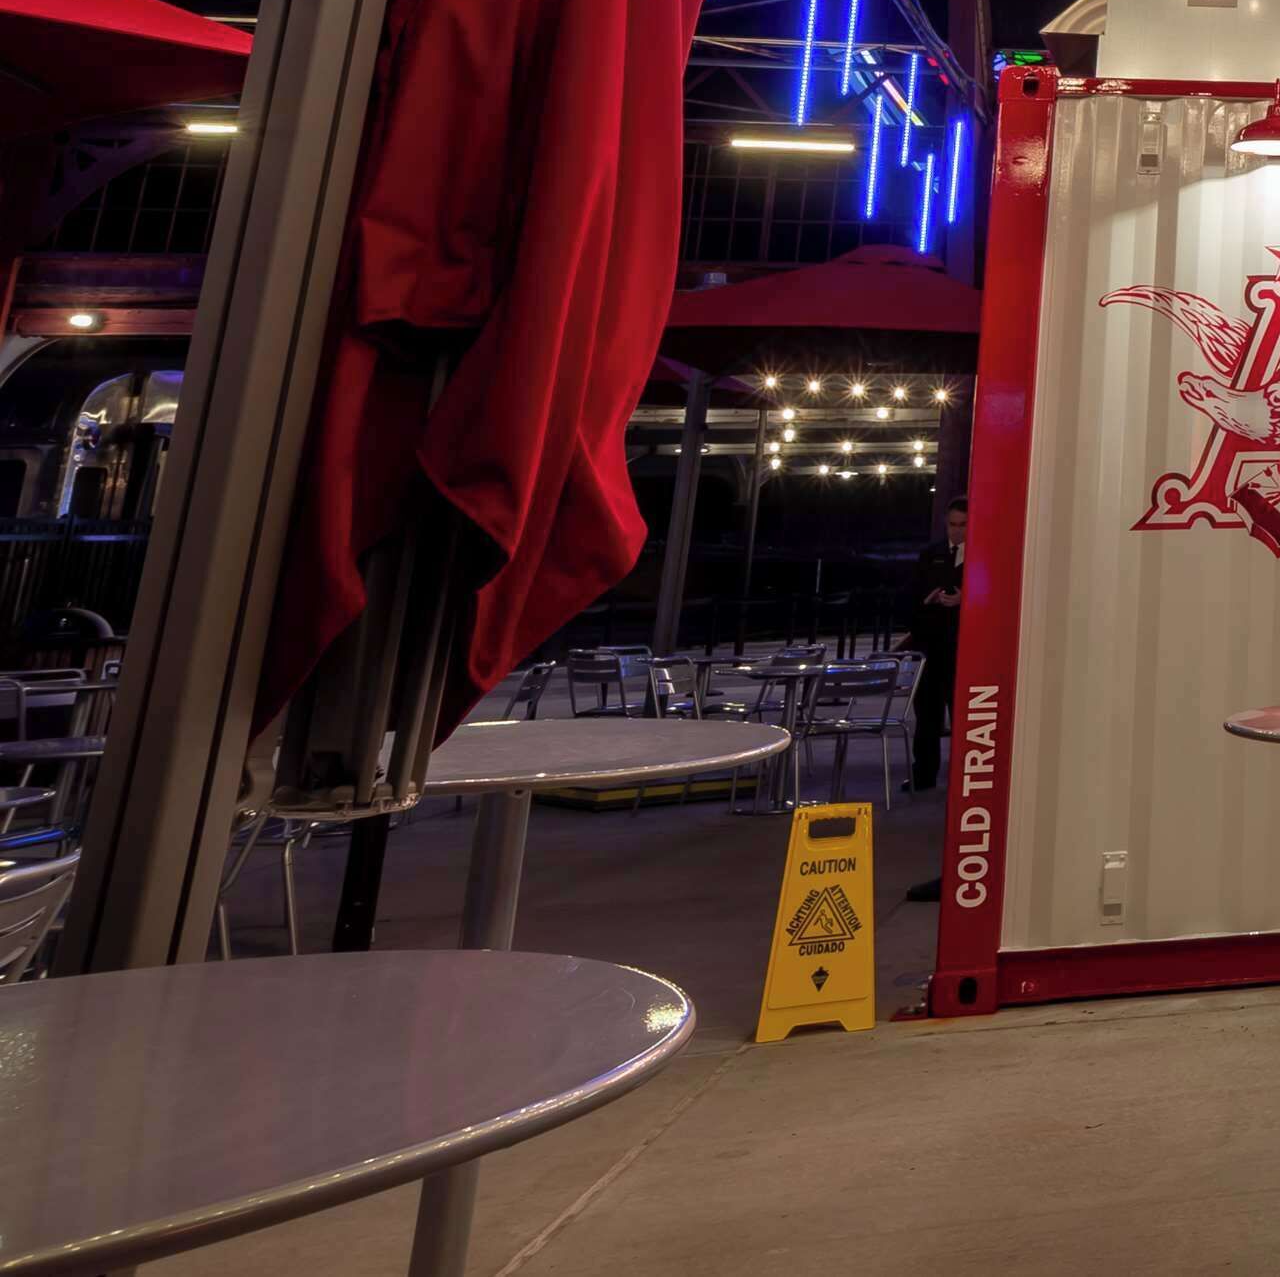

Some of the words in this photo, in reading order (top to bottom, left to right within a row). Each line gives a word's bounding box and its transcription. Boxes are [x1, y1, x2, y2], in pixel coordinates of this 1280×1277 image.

[963, 685, 1000, 797] TRAIN
[800, 857, 857, 876] CAUTION
[955, 805, 992, 908] COLD
[786, 888, 820, 936] ACHTUNG
[829, 884, 862, 932] ATTENTION
[798, 941, 845, 957] CUIDADO
